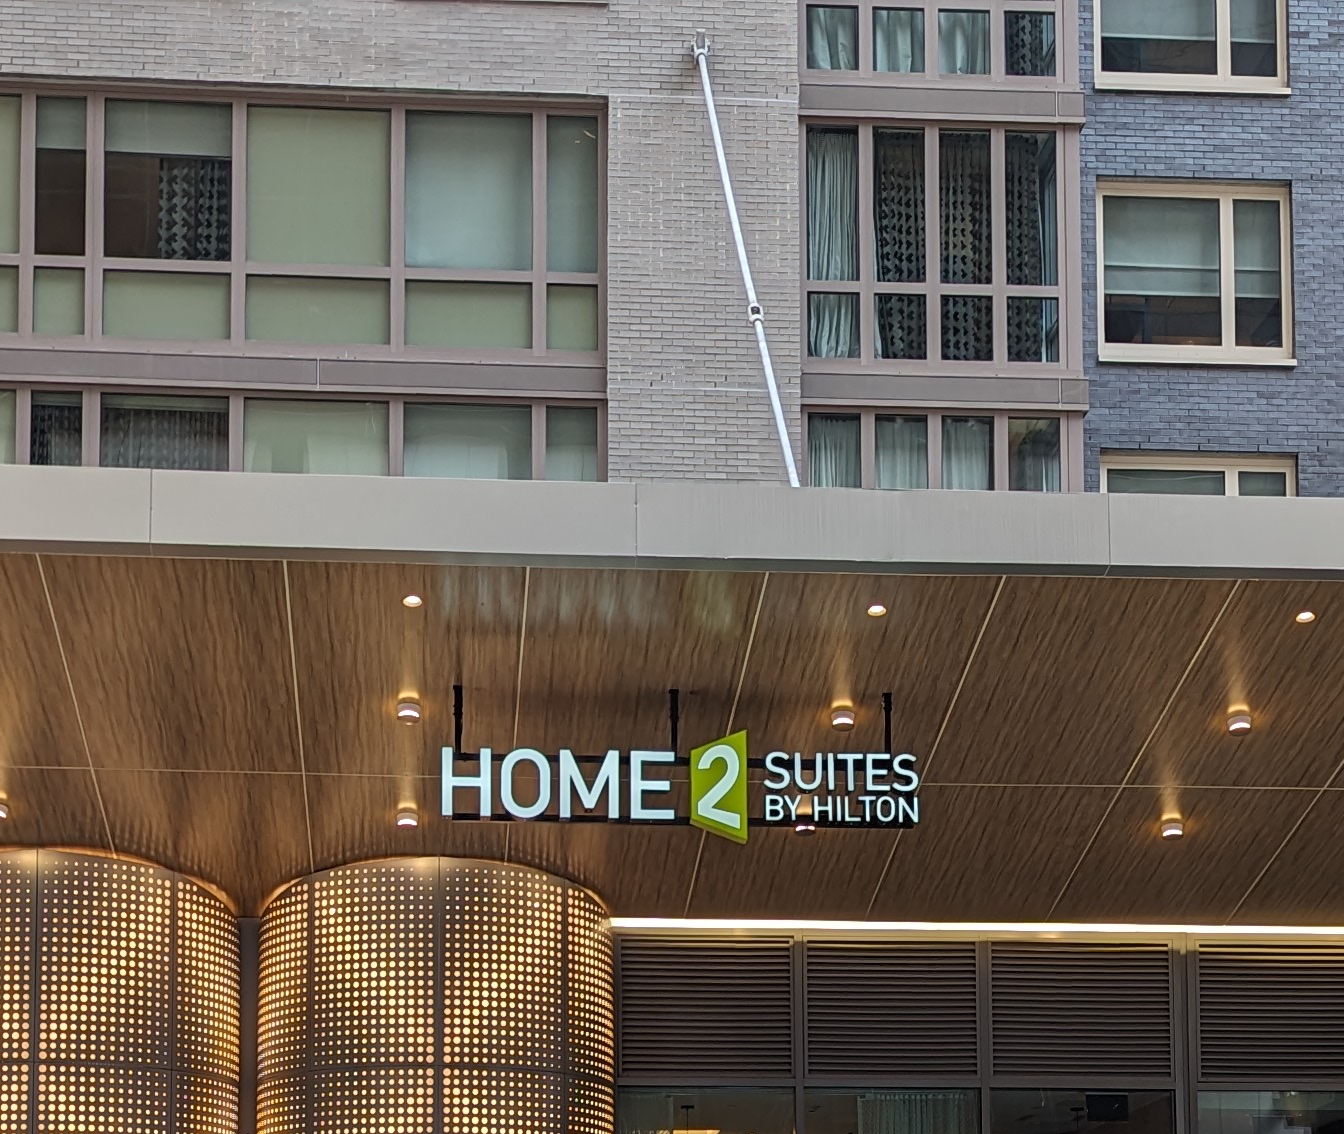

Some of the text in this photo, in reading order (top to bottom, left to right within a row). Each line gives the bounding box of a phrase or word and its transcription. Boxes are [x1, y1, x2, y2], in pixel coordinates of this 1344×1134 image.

[441, 746, 676, 820] HOME
[763, 751, 920, 793] SUITES
[764, 794, 920, 824] BY HILTON
